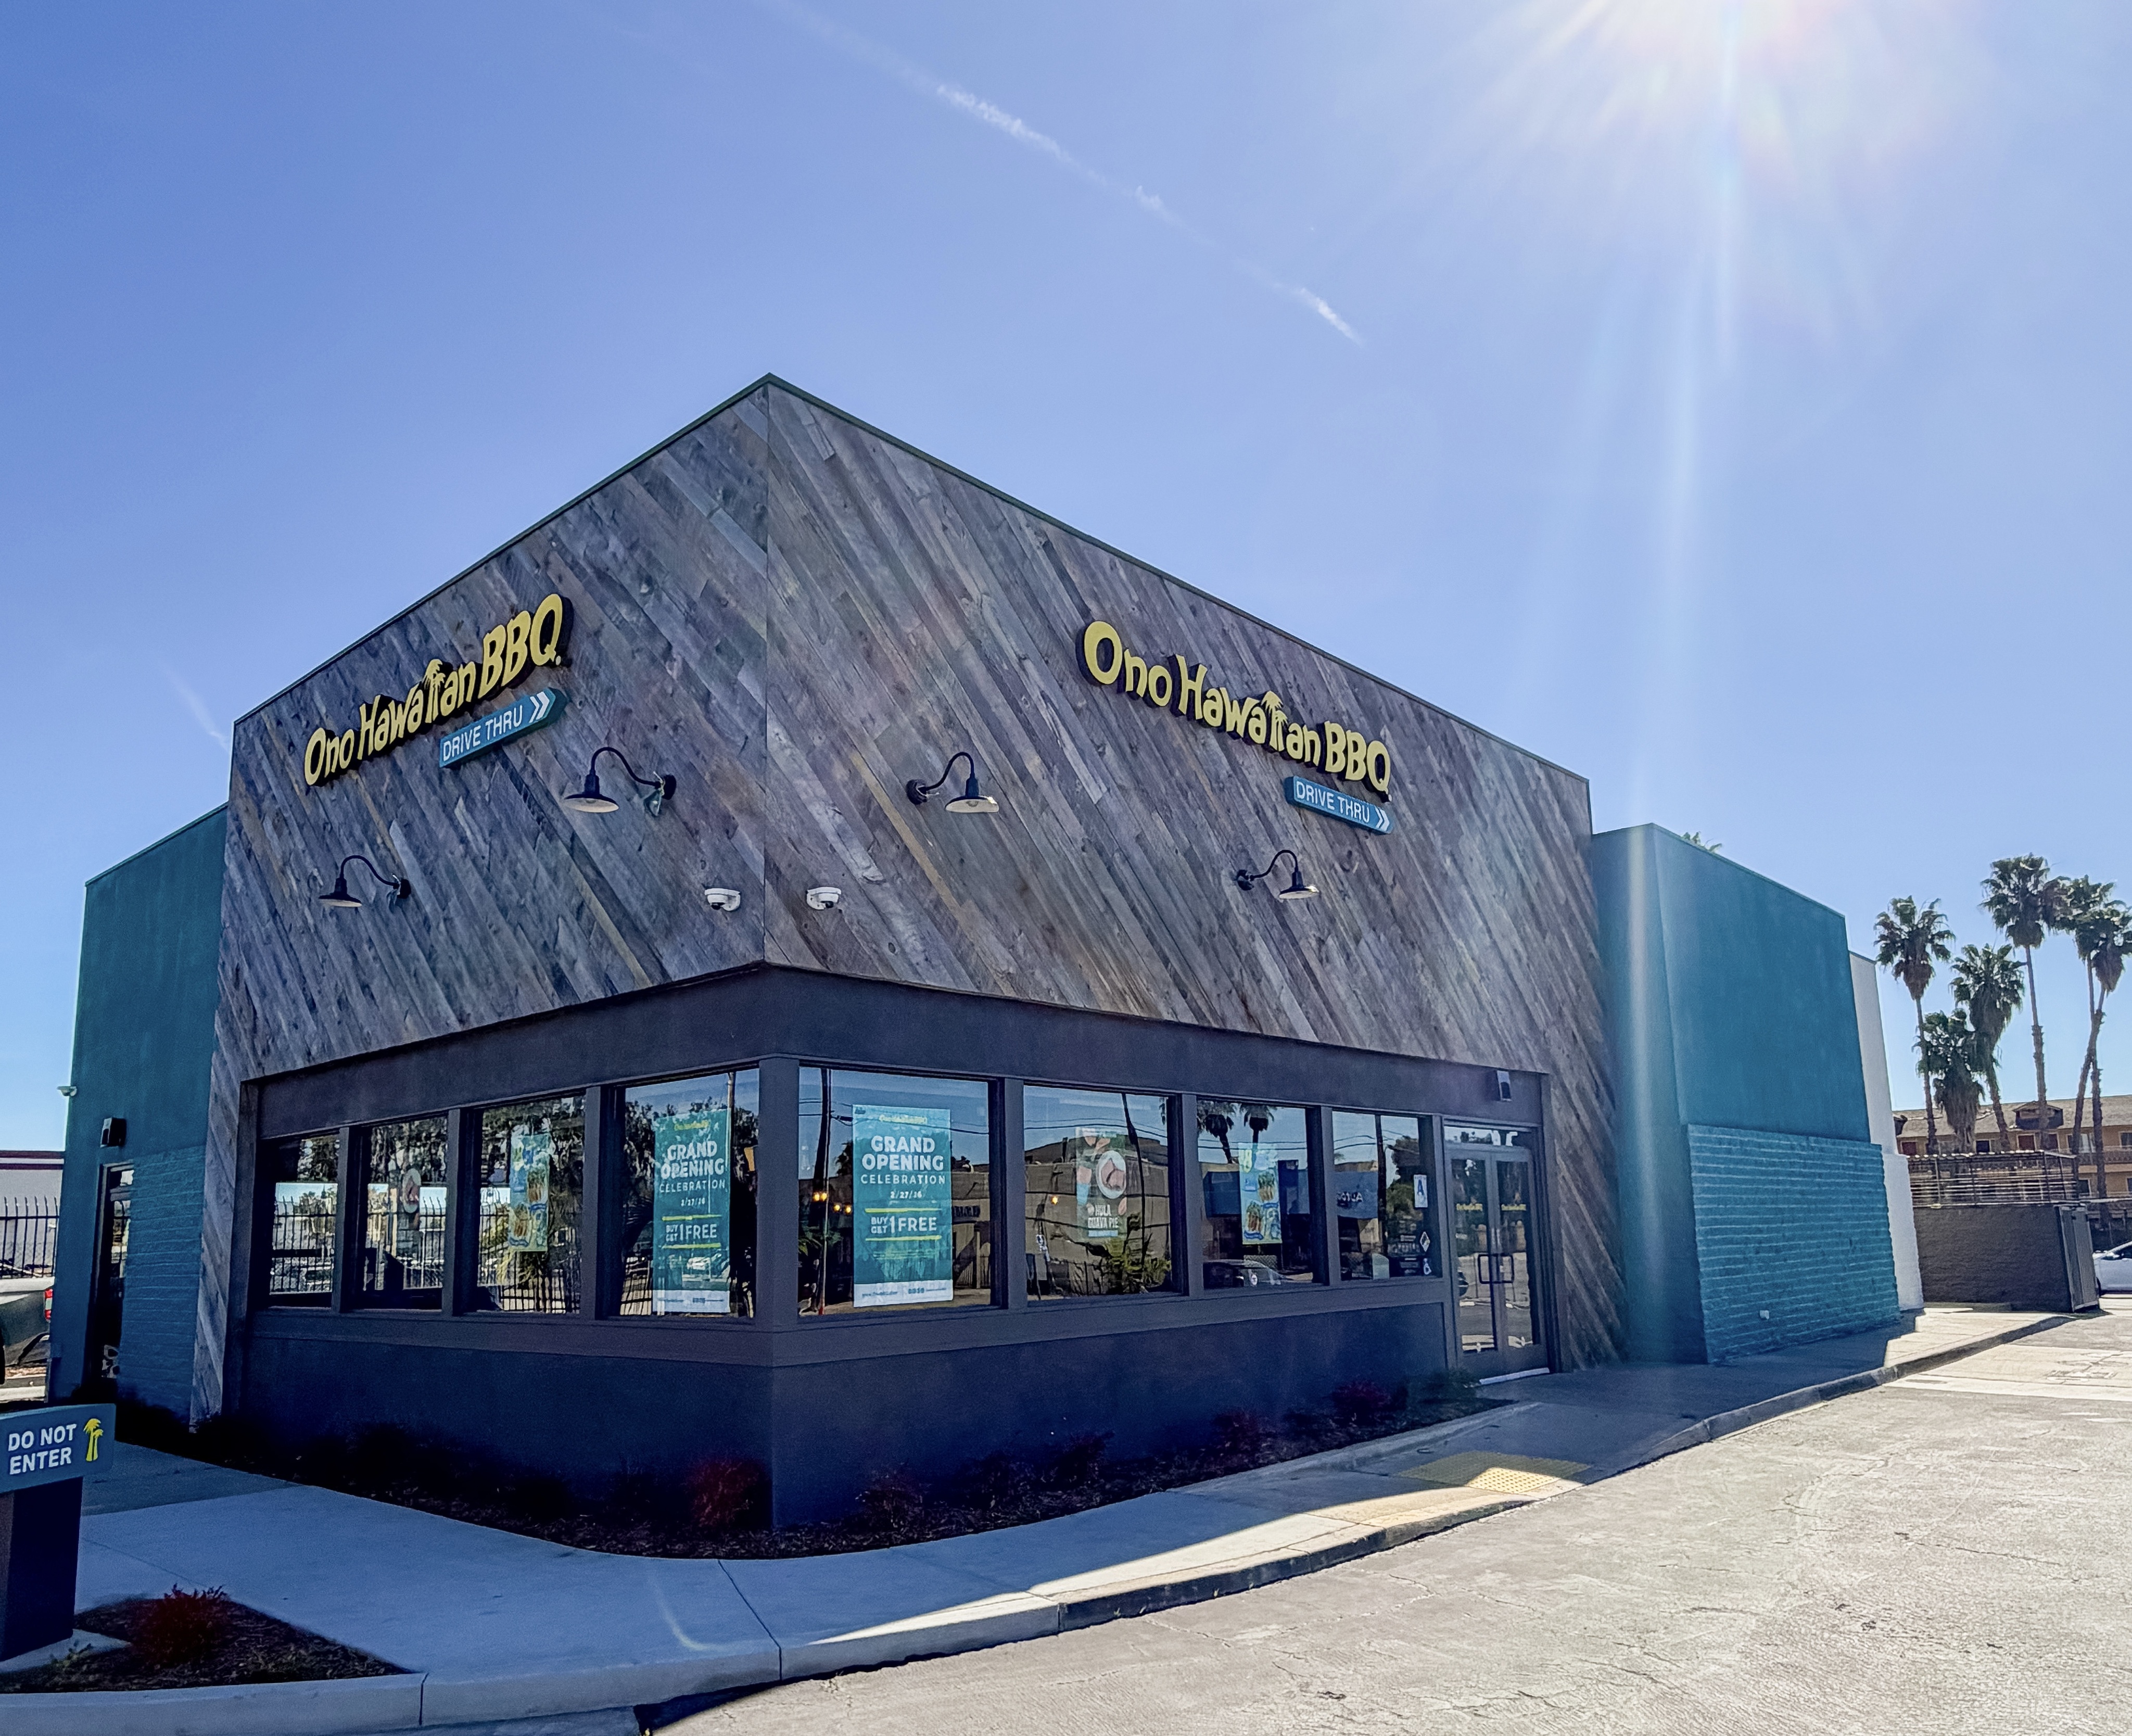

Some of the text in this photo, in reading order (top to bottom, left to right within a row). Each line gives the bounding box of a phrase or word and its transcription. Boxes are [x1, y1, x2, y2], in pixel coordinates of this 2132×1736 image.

[304, 728, 354, 785] Ono
[478, 594, 563, 699] BBQ
[1084, 622, 1172, 707] Ono
[1325, 720, 1391, 793] BBQ
[443, 705, 523, 761] DRIVE THRU
[1296, 781, 1369, 823] DRIVE THRU
[667, 1141, 717, 1160] GRAND
[871, 1135, 935, 1153] GRAND
[661, 1158, 725, 1179] OPENING
[862, 1154, 944, 1171] OPENING
[659, 1179, 725, 1193] CELEBRATION
[861, 1174, 945, 1184] CELEBRATION
[871, 1217, 888, 1225] BUY
[890, 1216, 937, 1233] 1 FREE
[686, 1224, 717, 1239] FREE
[8, 1424, 77, 1451] DO NOT
[9, 1447, 71, 1475] ENTER
